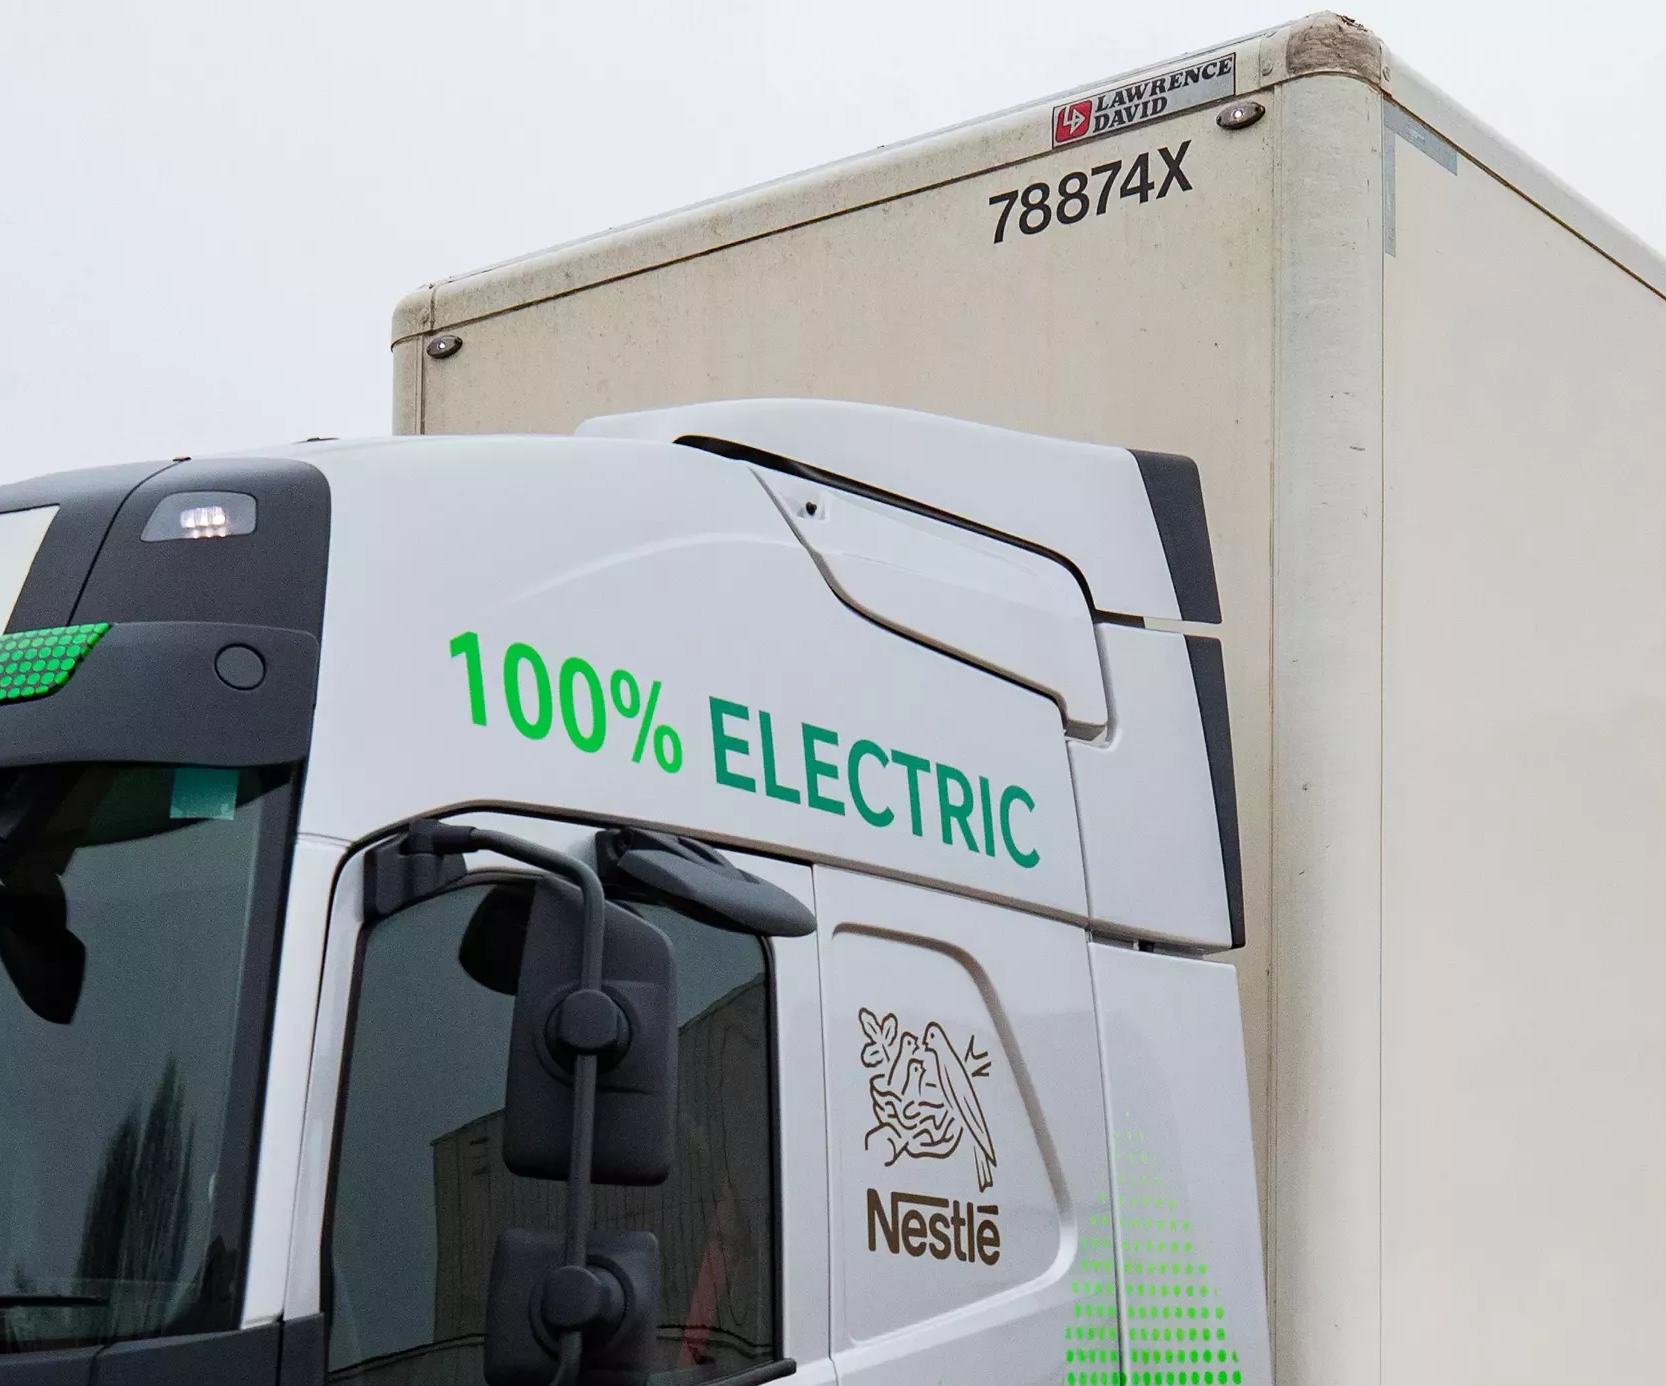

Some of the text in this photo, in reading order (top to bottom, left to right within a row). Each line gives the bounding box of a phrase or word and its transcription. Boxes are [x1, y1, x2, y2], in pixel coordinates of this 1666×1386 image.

[1092, 96, 1168, 134] DAVID
[1095, 53, 1232, 112] LAWRENCE
[989, 140, 1193, 244] 78874X
[449, 631, 1041, 869] 100% ELECTRIC
[866, 1188, 1001, 1266] Nestlé
